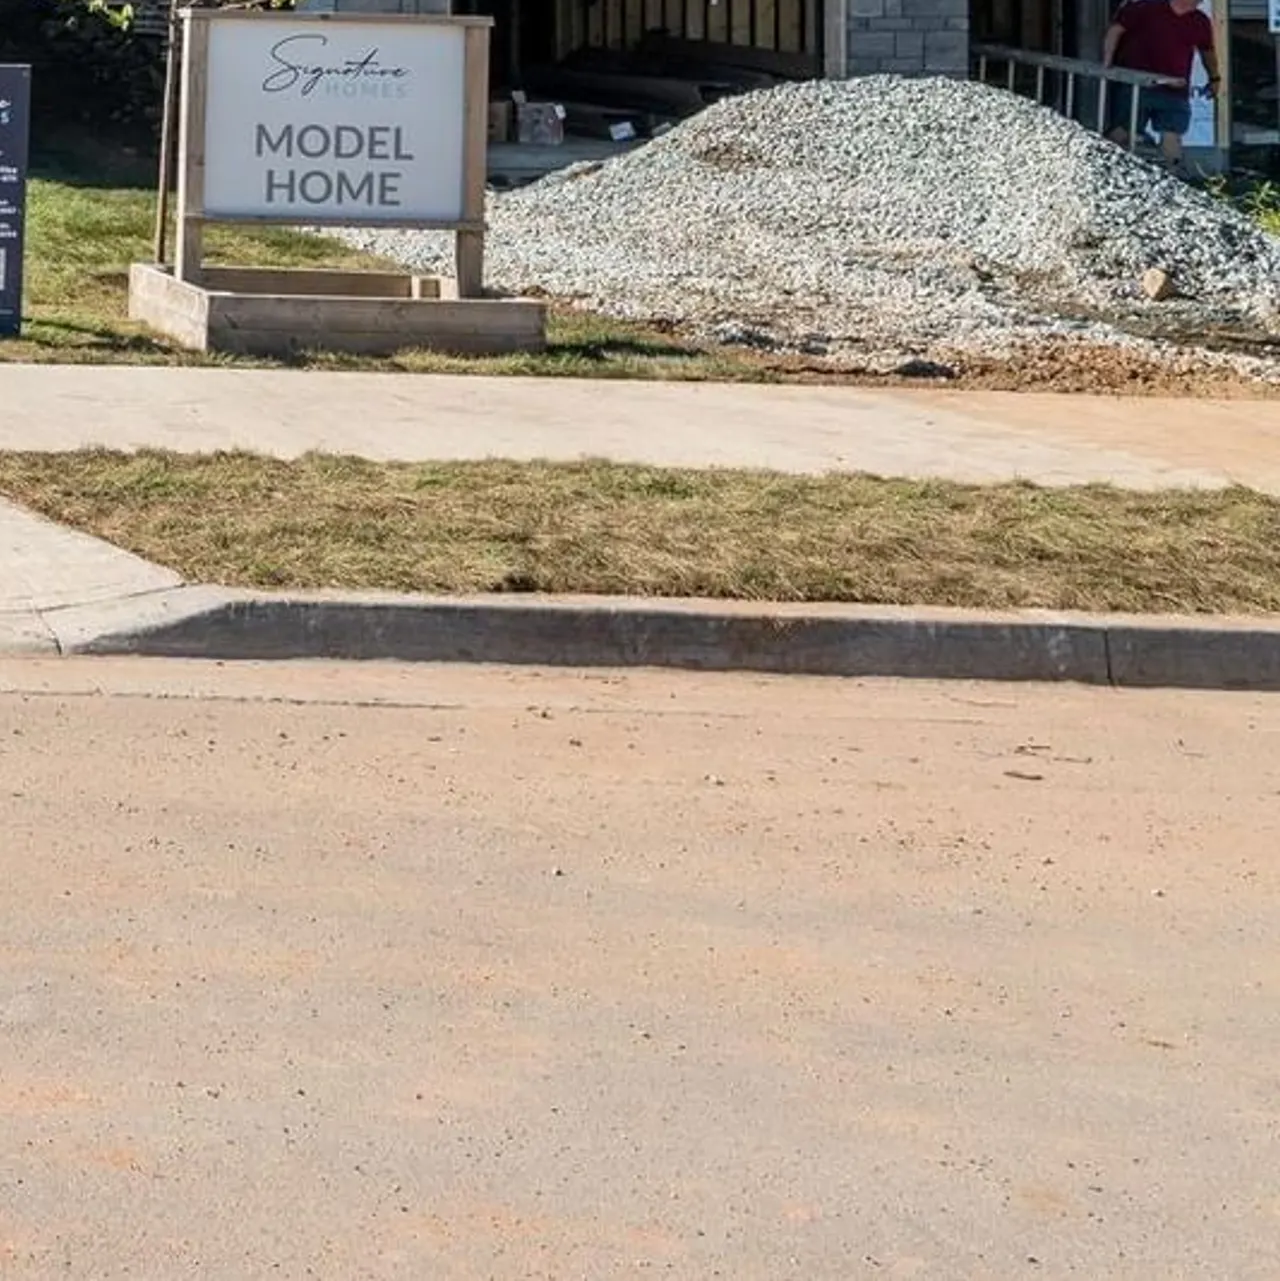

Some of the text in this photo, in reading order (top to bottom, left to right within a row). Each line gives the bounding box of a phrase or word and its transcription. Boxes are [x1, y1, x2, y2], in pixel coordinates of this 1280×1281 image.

[262, 34, 411, 95] Signature
[325, 81, 408, 99] HOMES
[255, 123, 414, 161] MODEL
[265, 169, 402, 207] HOME
